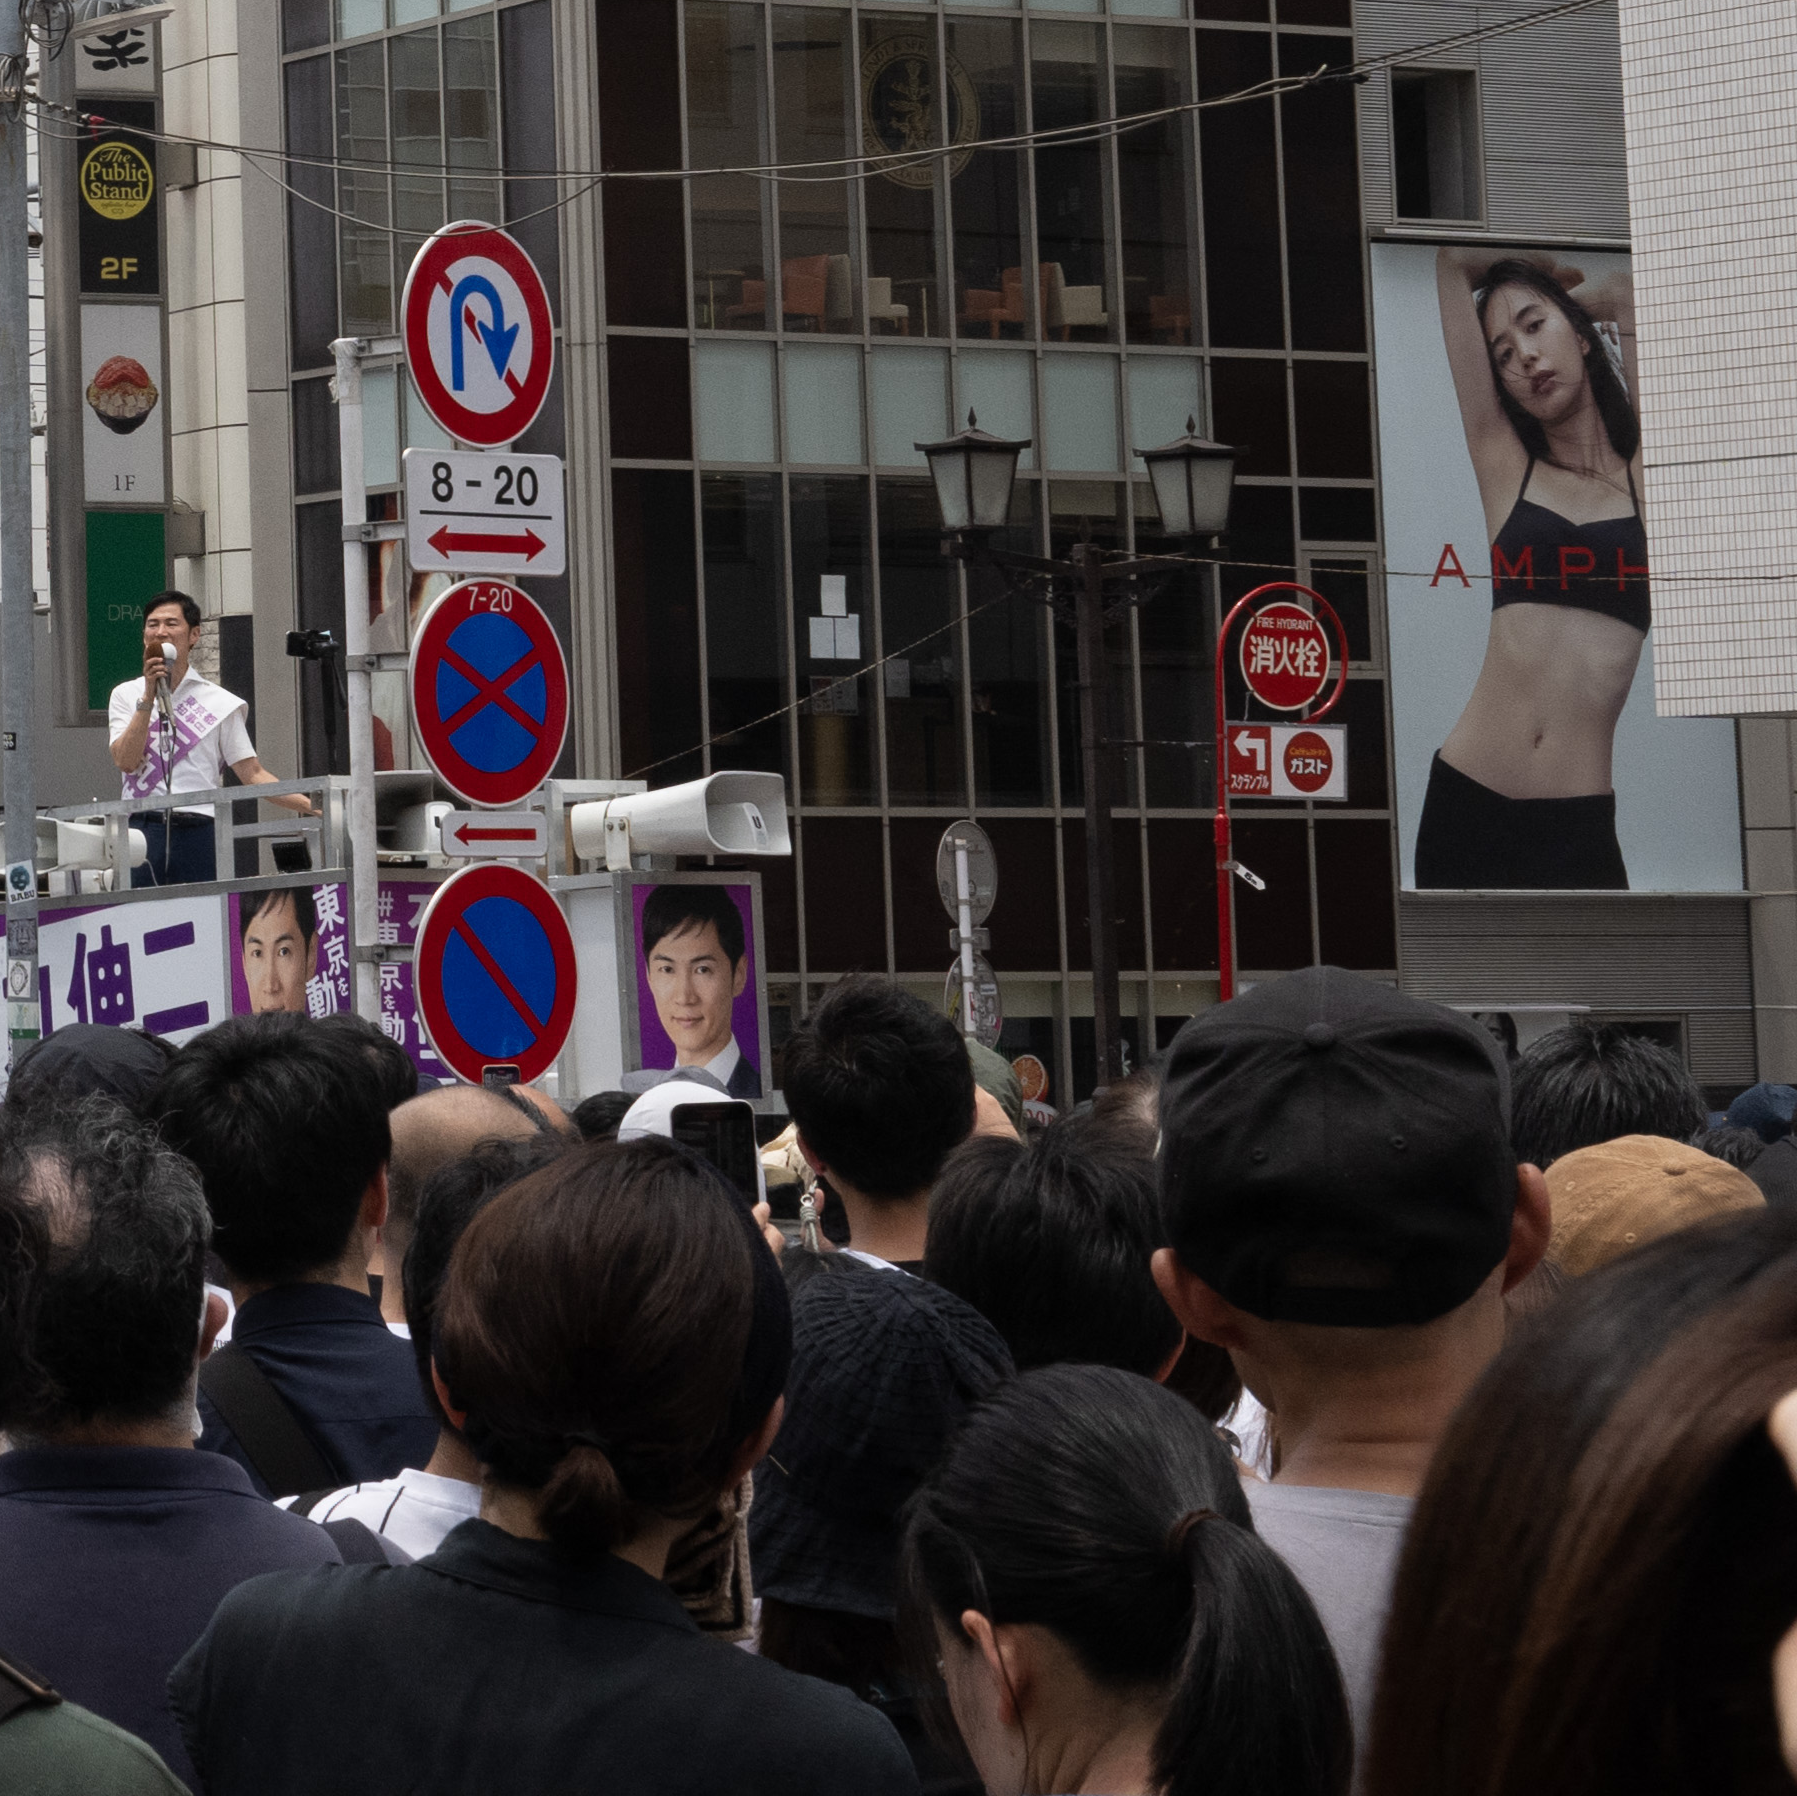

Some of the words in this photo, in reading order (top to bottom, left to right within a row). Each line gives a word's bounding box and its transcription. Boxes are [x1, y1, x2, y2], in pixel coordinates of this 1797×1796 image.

[90, 162, 148, 184] Public
[90, 183, 145, 202] Stand
[100, 257, 139, 280] 2F
[114, 474, 136, 491] 1F
[467, 585, 513, 613] 7-20
[1256, 616, 1275, 629] FIRE
[1276, 618, 1313, 631] HYDRANT
[1249, 634, 1322, 678] 消火栓
[1290, 758, 1328, 776] ガスト
[1231, 774, 1270, 790] スクランブル
